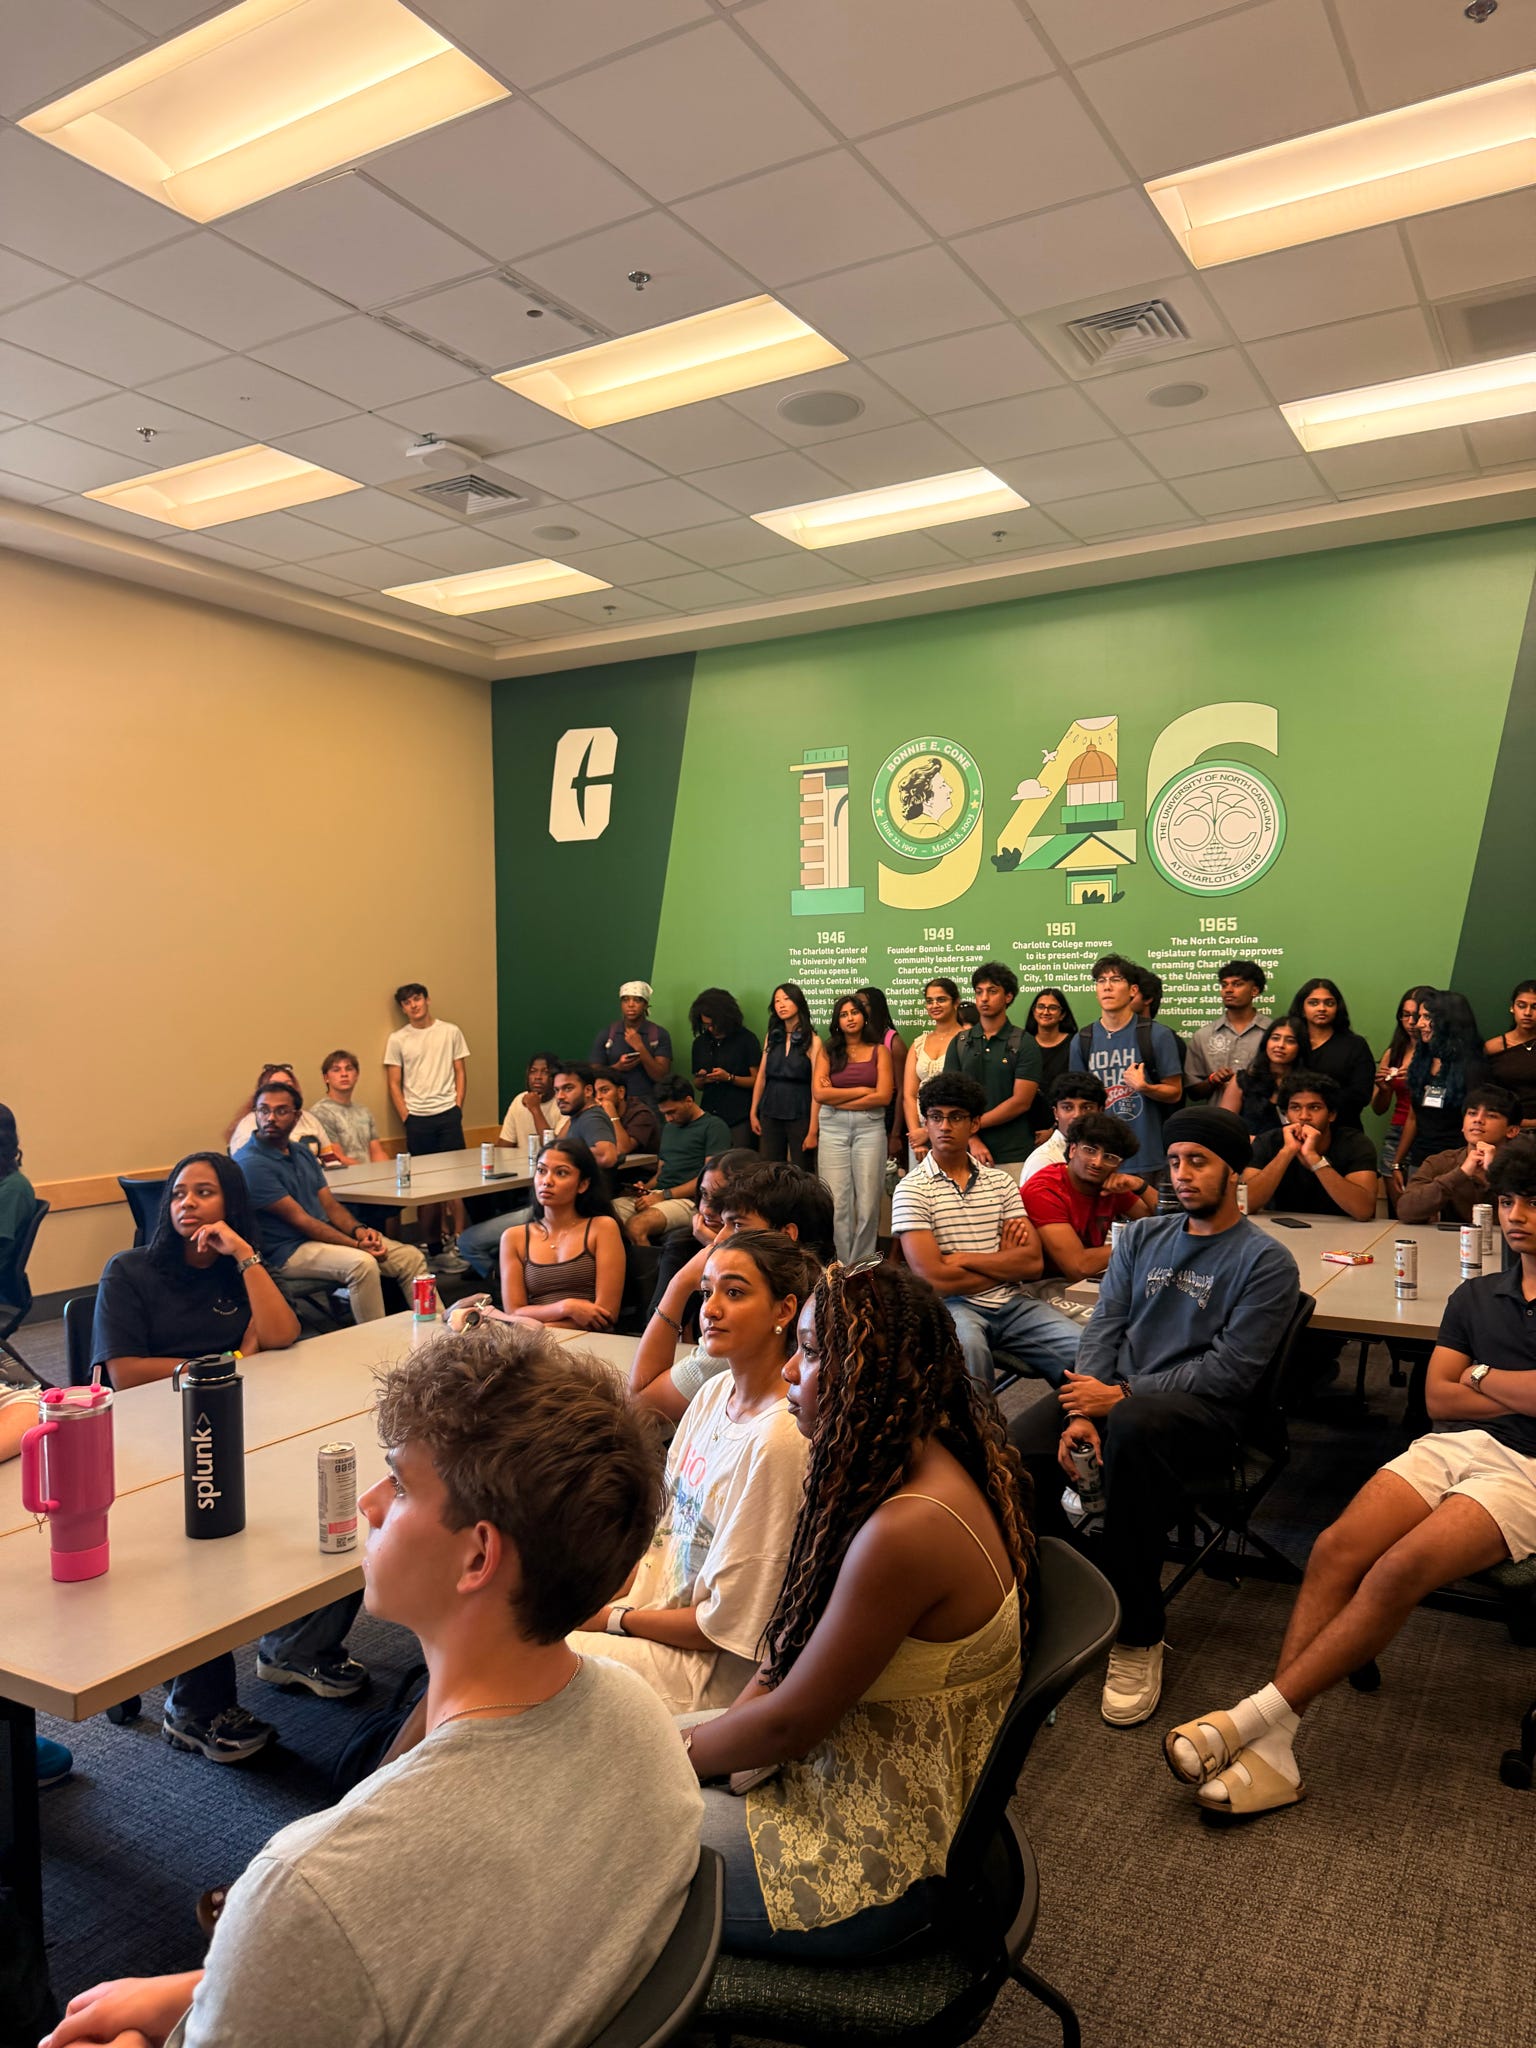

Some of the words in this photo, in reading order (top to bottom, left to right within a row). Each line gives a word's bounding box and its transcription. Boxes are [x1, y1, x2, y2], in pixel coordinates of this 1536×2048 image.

[887, 742, 926, 772] BONNIE
[930, 742, 940, 750] E.
[944, 744, 971, 770] CONE
[1162, 777, 1202, 820] UNIVERSITY
[1204, 774, 1218, 782] OF
[1220, 774, 1252, 790] NORTH
[1250, 787, 1272, 832] CAROLINA
[880, 820, 894, 837] June
[932, 836, 956, 854] March
[1170, 861, 1182, 872] AT
[1182, 869, 1240, 883] CHARLOTTE
[1241, 853, 1262, 873] 1946
[1046, 922, 1076, 936] 1961
[1199, 917, 1238, 932] 1965
[816, 931, 846, 944] 1946
[923, 927, 954, 940] 1949
[1052, 940, 1083, 950] College
[1170, 937, 1188, 946] The
[1190, 936, 1216, 945] North
[1218, 936, 1258, 944] Carolina
[788, 948, 802, 956] The
[802, 948, 834, 956] Charlotte
[860, 946, 868, 954] of
[887, 946, 917, 954] Founder
[918, 945, 944, 953] Bonnie
[946, 944, 954, 952] E.
[955, 944, 974, 952] Cone
[976, 942, 990, 951] and
[1026, 952, 1034, 960] to
[1036, 952, 1046, 960] its
[1048, 951, 1098, 960] present-day
[1148, 949, 1196, 959] legislature
[1198, 948, 1238, 958] formally
[1239, 948, 1284, 957] approves
[790, 958, 802, 966] the
[802, 957, 836, 966] University
[846, 956, 867, 964] North
[894, 956, 934, 964] community
[936, 954, 964, 962] leaders
[898, 966, 932, 974] Charlotte
[1052, 962, 1060, 970] in
[1062, 962, 1094, 970] Univers
[1152, 961, 1194, 970] renaming
[798, 968, 828, 976] Carolina
[828, 968, 850, 976] opens
[1168, 972, 1184, 980] the
[1185, 972, 1218, 980] Univer
[826, 977, 852, 985] Central
[852, 976, 870, 986] High
[892, 977, 922, 985] closure,
[1024, 974, 1042, 983] City,
[1080, 972, 1092, 980] fro
[834, 986, 858, 995] evenin
[1062, 984, 1097, 992] Charlott
[1162, 984, 1200, 992] Carolina
[1202, 984, 1210, 992] at
[1160, 996, 1196, 1005] ur-year
[898, 1008, 912, 1016] that
[1158, 1007, 1204, 1015] institution
[1206, 1006, 1222, 1014] and
